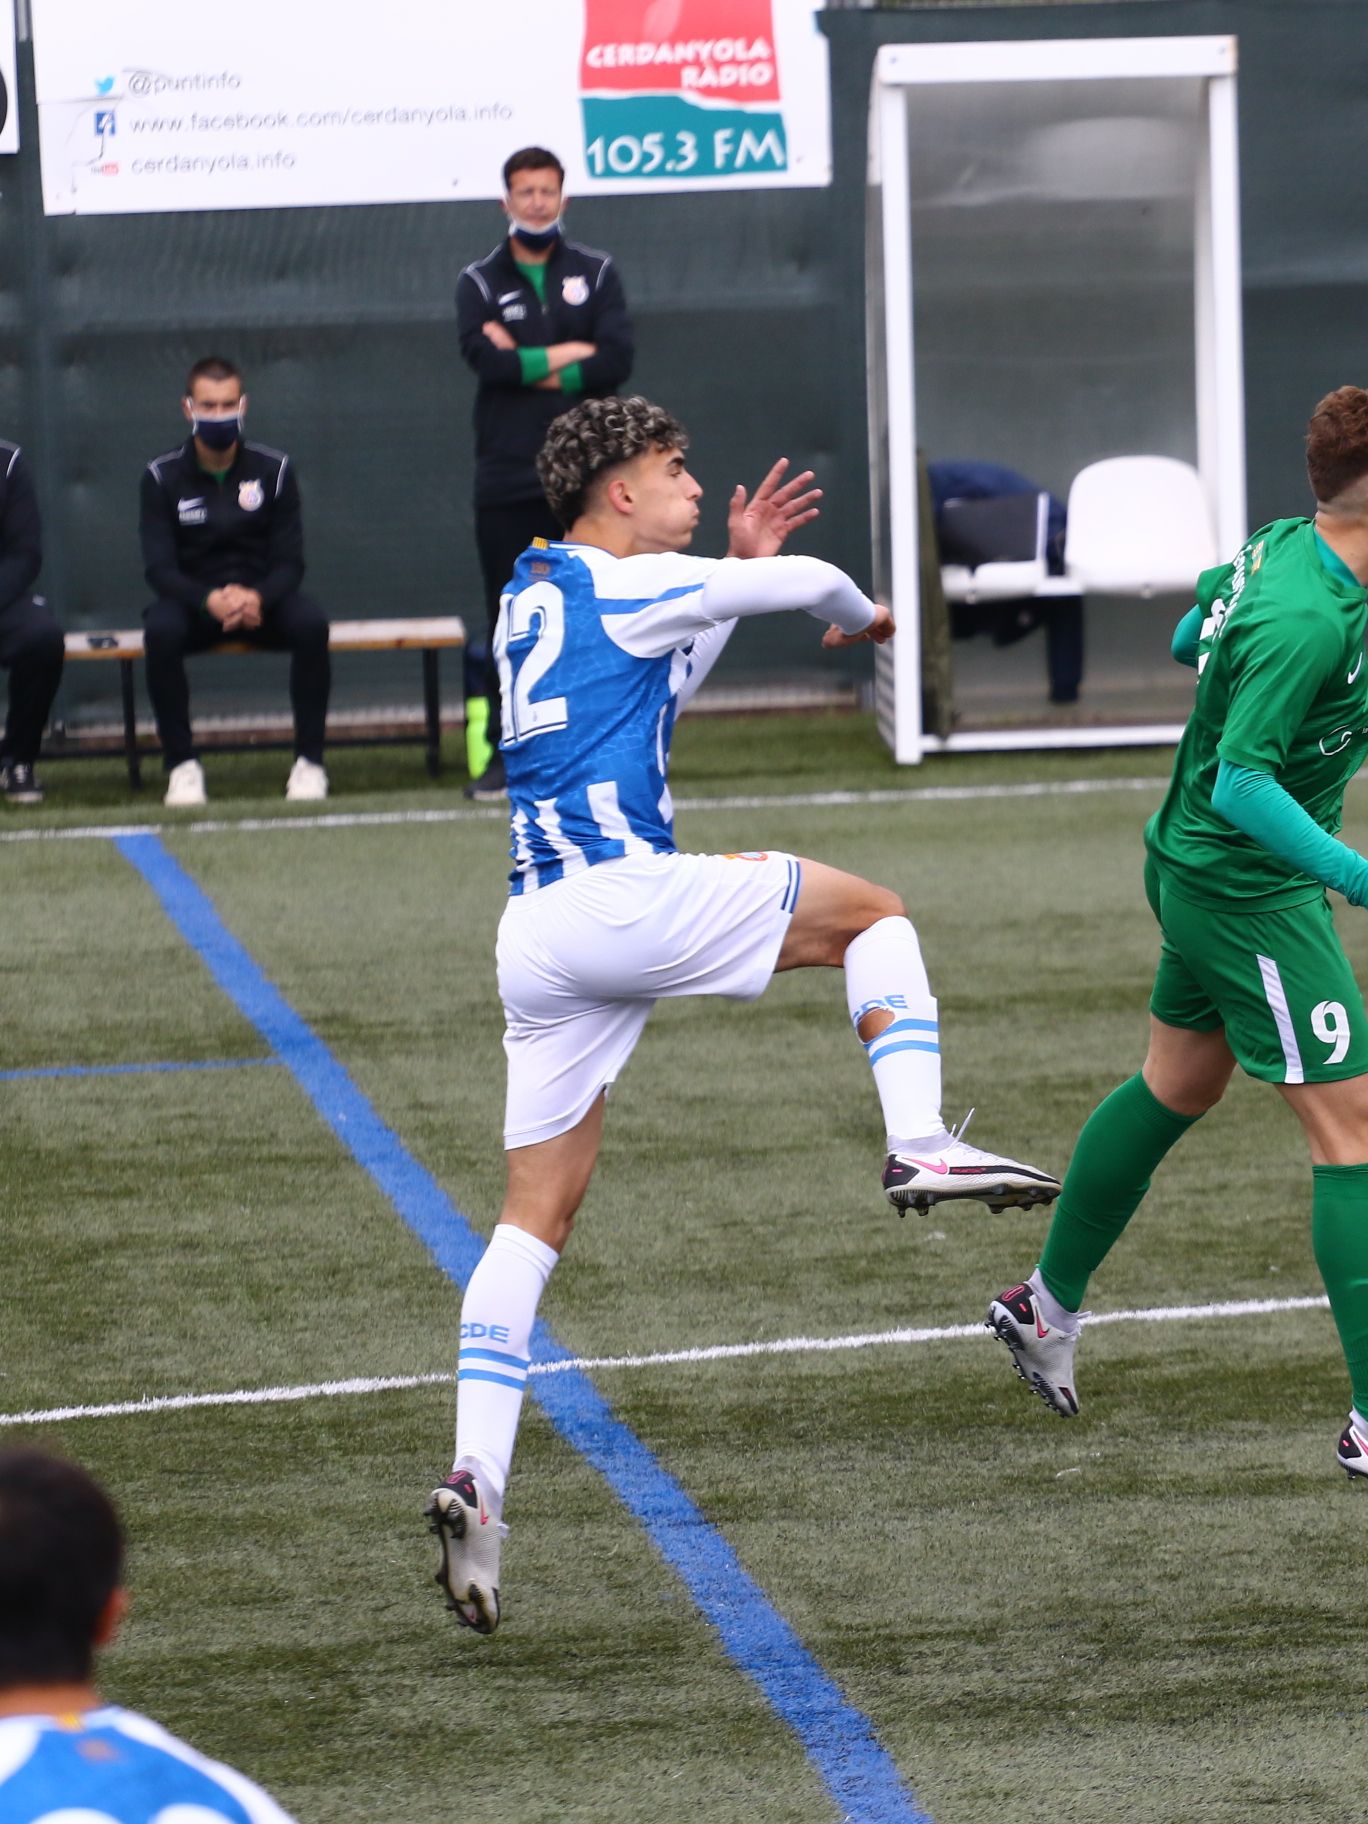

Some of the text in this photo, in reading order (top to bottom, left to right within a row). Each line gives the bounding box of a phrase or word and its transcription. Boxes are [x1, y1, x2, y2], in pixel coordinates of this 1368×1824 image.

[586, 37, 771, 68] CERDANYOLA
[128, 70, 241, 96] @puntinfo
[130, 150, 297, 175] cerdanyola.info
[587, 128, 786, 174] 105.3 FM
[493, 581, 568, 746] 12
[1310, 1000, 1351, 1065] 9
